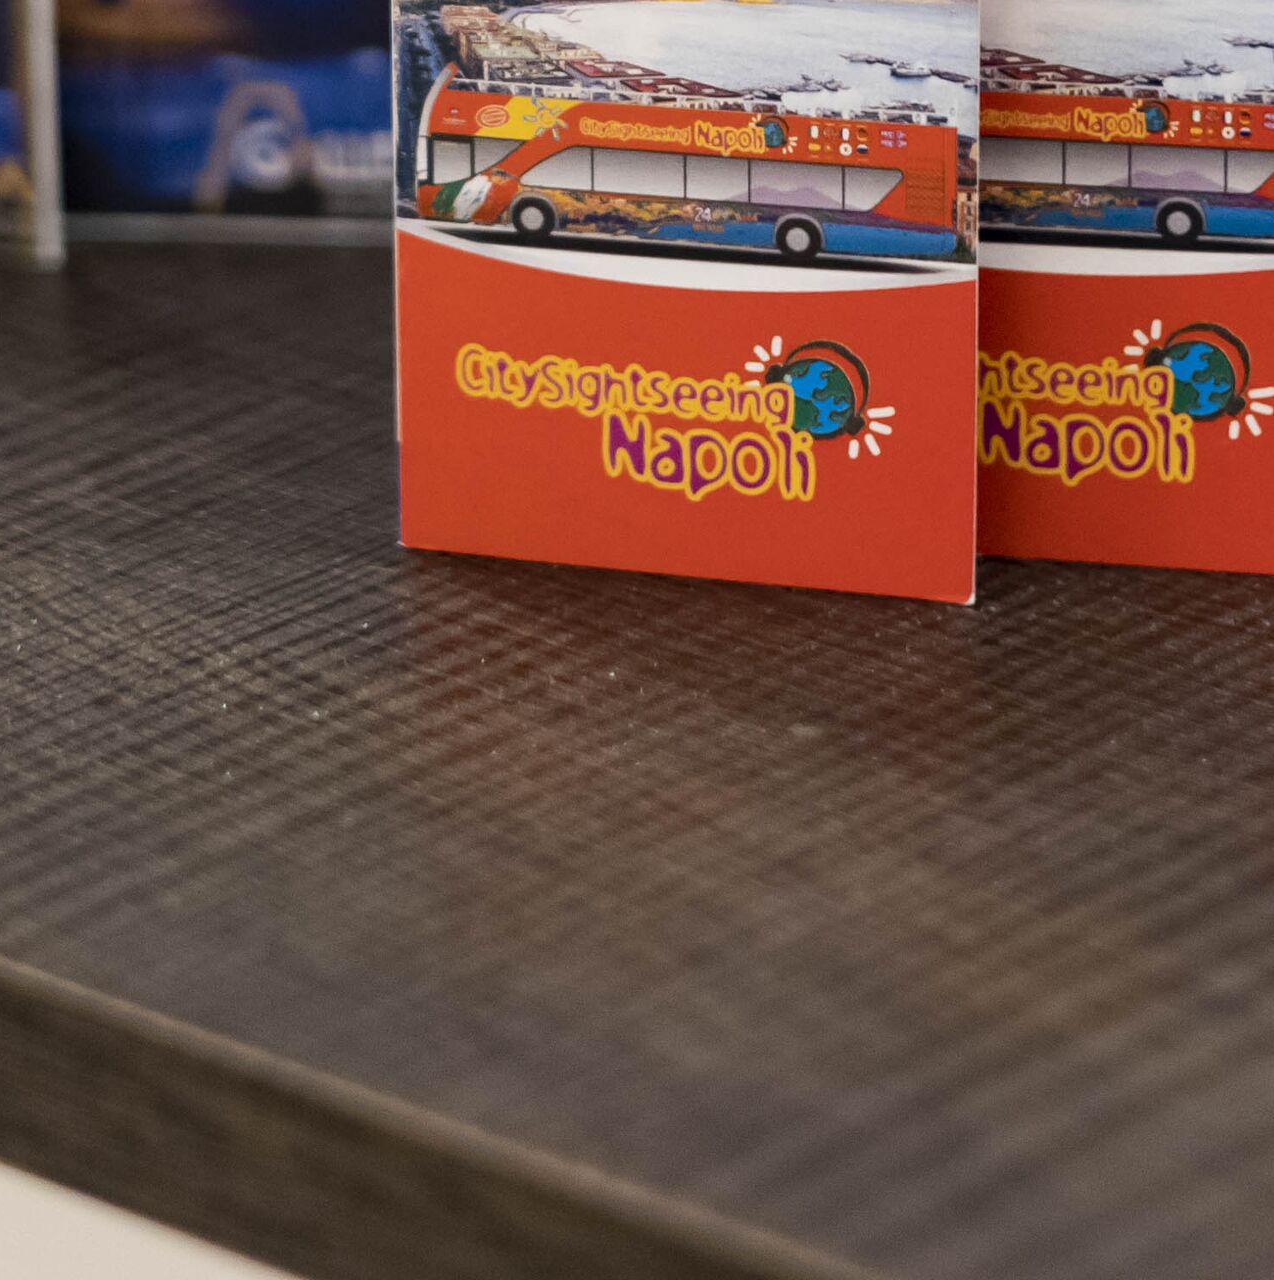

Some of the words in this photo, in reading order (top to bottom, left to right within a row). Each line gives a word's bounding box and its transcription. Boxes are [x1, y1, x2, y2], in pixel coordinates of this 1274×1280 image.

[693, 119, 769, 156] Napoli
[1073, 106, 1148, 142] Napoli
[456, 343, 795, 428] CitySightseeing
[602, 408, 816, 502] Napoli
[978, 395, 1195, 487] Napoli
